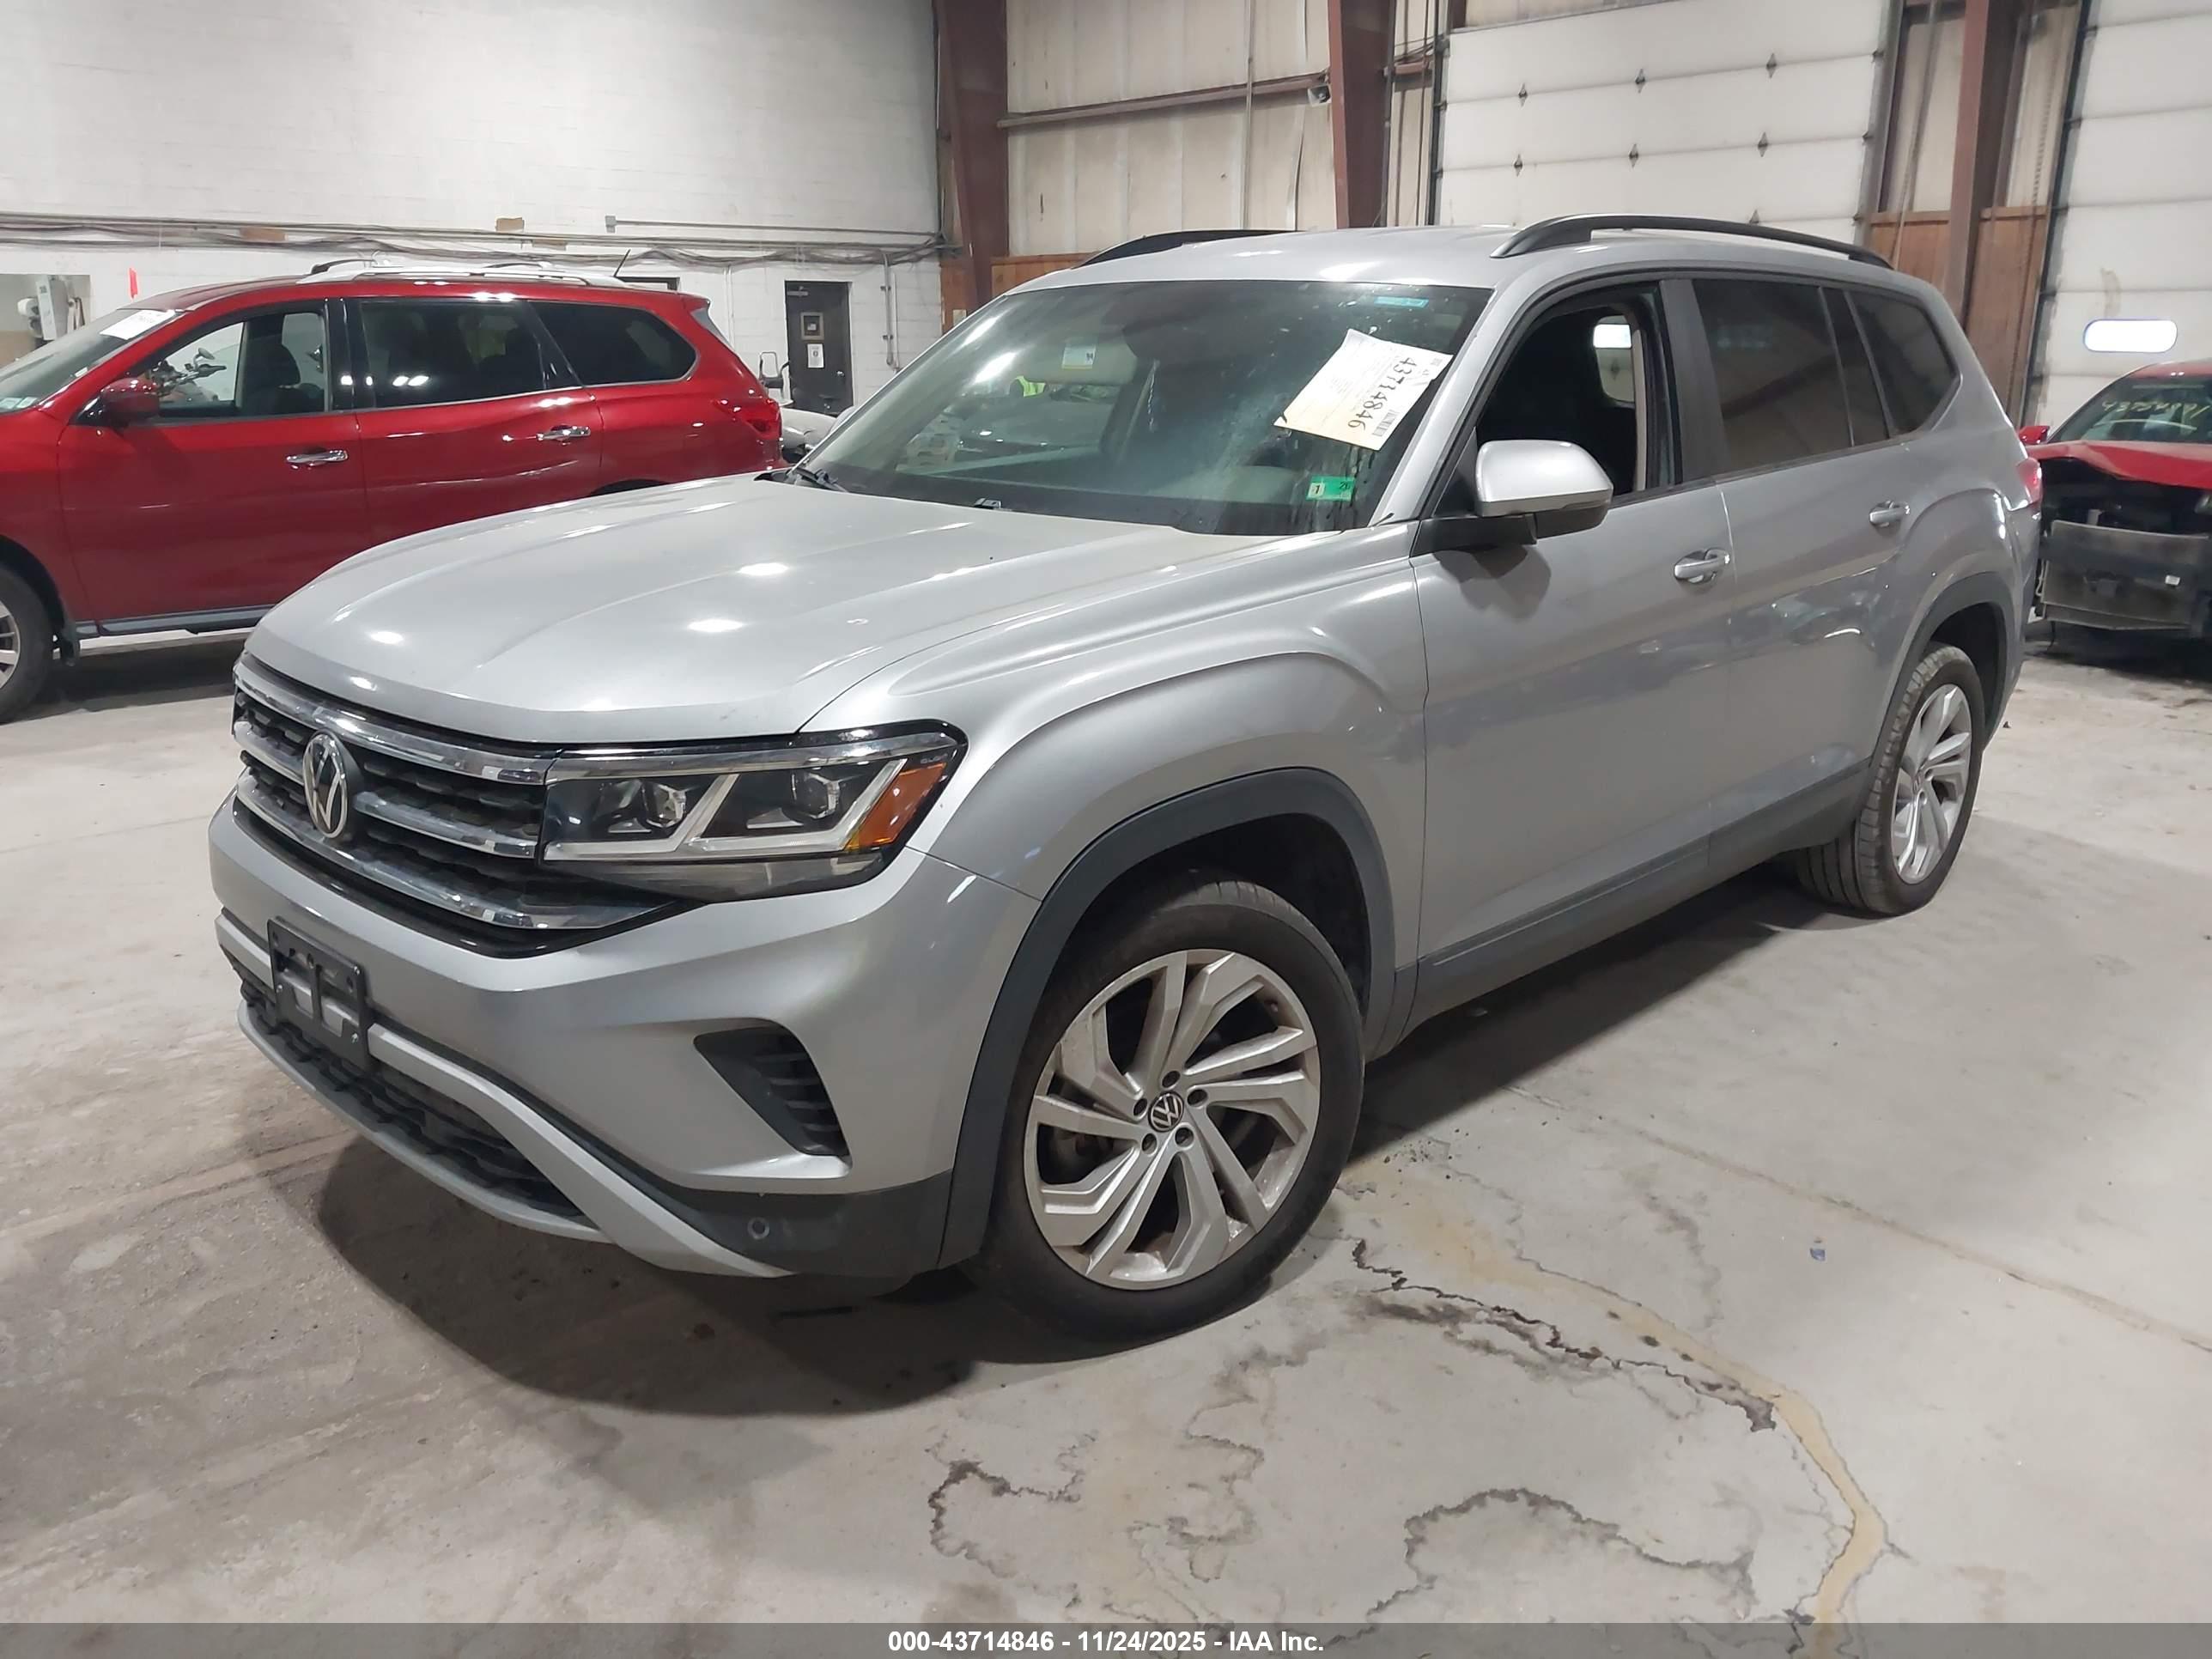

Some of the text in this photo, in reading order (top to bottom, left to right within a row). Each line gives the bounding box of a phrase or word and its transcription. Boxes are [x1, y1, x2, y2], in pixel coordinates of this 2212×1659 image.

[1347, 357, 1417, 431] 43714846
[303, 733, 348, 839] VW
[1150, 1092, 1184, 1132] VW
